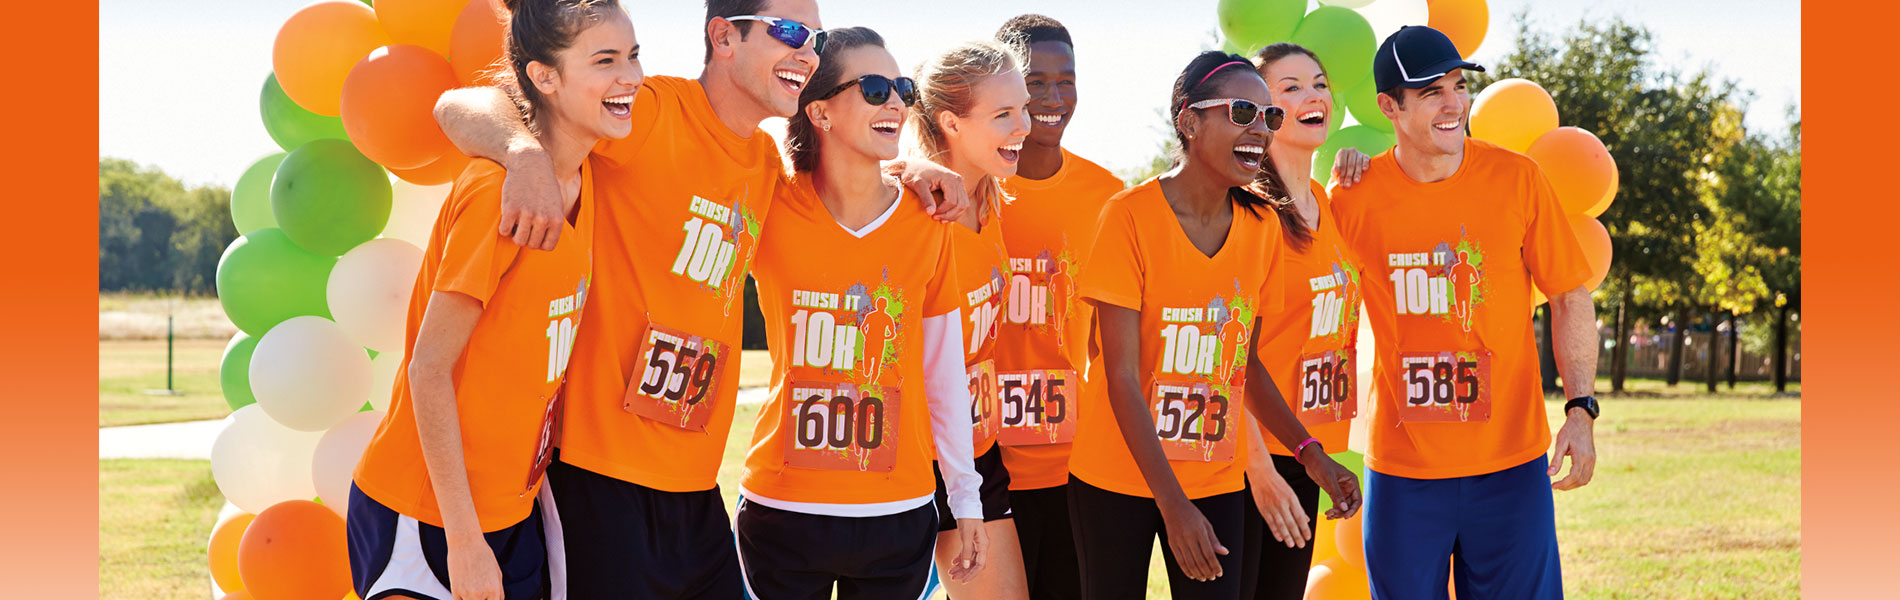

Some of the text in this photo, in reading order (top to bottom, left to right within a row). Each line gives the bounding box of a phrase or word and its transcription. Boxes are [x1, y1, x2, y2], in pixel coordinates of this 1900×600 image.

[688, 195, 730, 225] CRUSH
[671, 216, 735, 289] 10K
[1009, 258, 1048, 272] USH IT
[1388, 252, 1446, 266] CRUSH IT
[792, 290, 861, 311] CRUSH IT
[967, 277, 999, 307] CRUSH IT
[1002, 274, 1048, 325] 0K
[1310, 274, 1336, 291] CRUSH
[1389, 268, 1449, 315] 10K
[548, 295, 574, 318] CRUSH
[1162, 307, 1220, 322] CRUSH IT
[1310, 290, 1344, 338] 10K
[791, 310, 858, 370] 10K
[1161, 324, 1217, 375] 10K
[640, 339, 716, 405] 559
[1303, 359, 1347, 408] 586
[1409, 361, 1478, 404] 585
[970, 372, 992, 424] 28
[1004, 379, 1066, 425] 545
[1158, 391, 1228, 442] 523
[798, 394, 884, 450] 600
